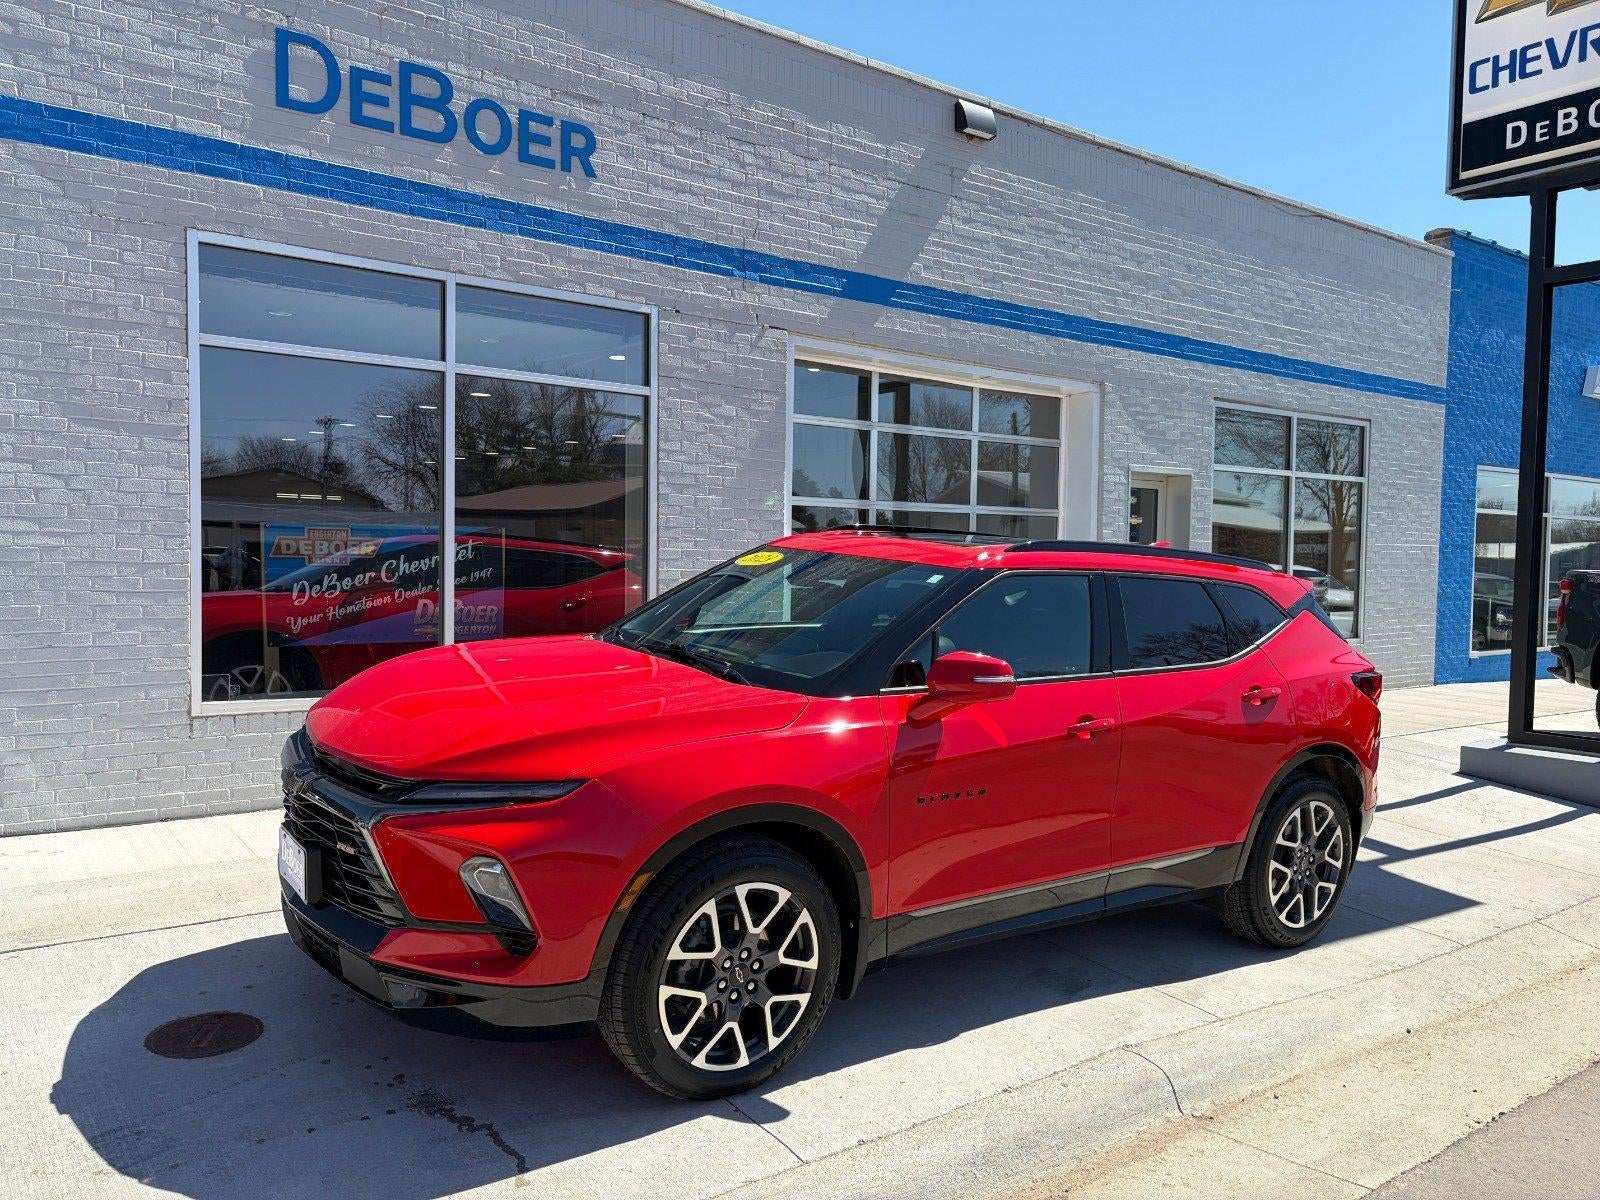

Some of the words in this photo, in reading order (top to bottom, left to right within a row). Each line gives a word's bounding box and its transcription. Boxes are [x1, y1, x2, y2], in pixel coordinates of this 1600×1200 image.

[309, 530, 347, 539] EDGERTON
[286, 613, 323, 634] Your
[326, 596, 392, 621] Hometown
[394, 583, 433, 603] Dealer
[470, 567, 493, 583] 1947
[292, 571, 376, 606] DeBoer
